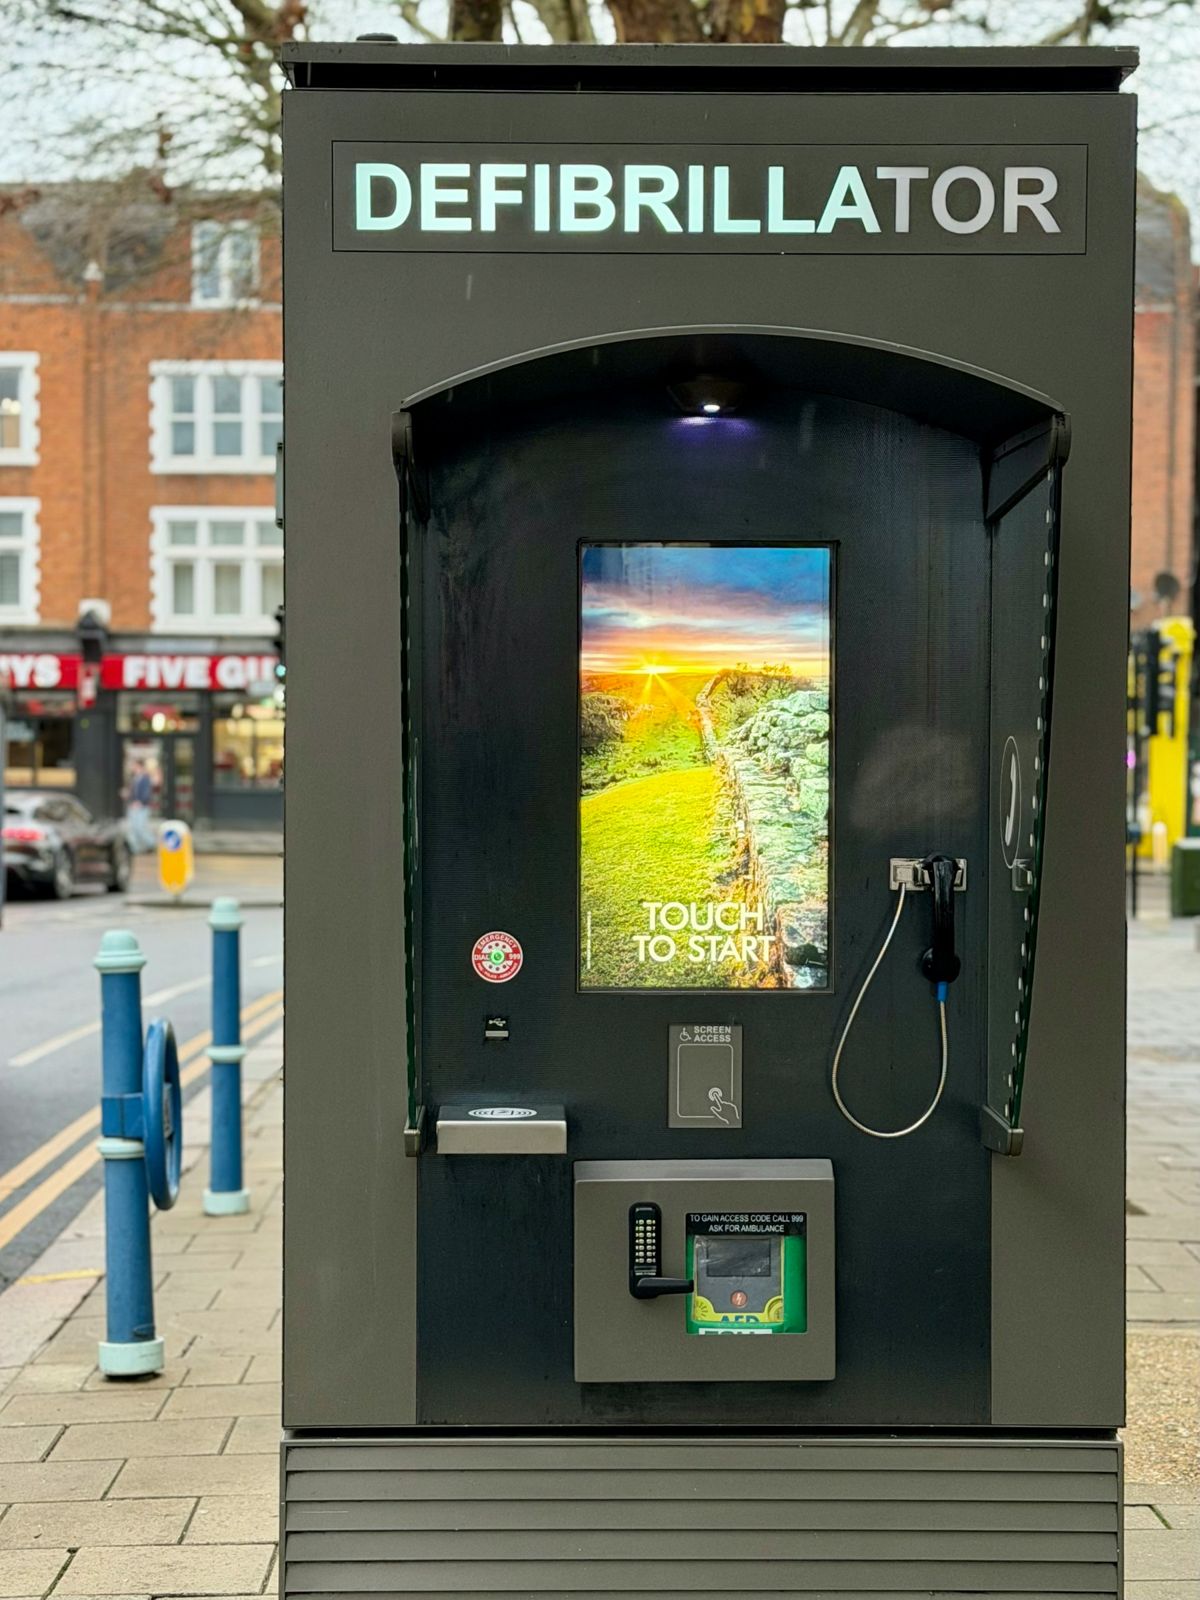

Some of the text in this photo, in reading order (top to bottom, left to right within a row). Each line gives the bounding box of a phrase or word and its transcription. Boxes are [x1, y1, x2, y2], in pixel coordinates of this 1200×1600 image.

[355, 162, 1061, 234] DEFIBRILLATOR
[0, 654, 62, 688] YS
[123, 656, 211, 688] FIVE
[642, 902, 763, 931] TOUCH
[477, 934, 517, 950] EMERGENCY
[633, 935, 775, 962] TO START
[474, 953, 490, 961] DIAL
[693, 1025, 732, 1034] SCREEN
[693, 1034, 732, 1043] ACCESS
[690, 1214, 700, 1223] TO
[701, 1214, 719, 1223] GAIN
[720, 1214, 749, 1223] ACCESS
[750, 1214, 771, 1223] CODE
[772, 1214, 790, 1223] CALL
[708, 1224, 785, 1233] ASK FOR AMBULANCE
